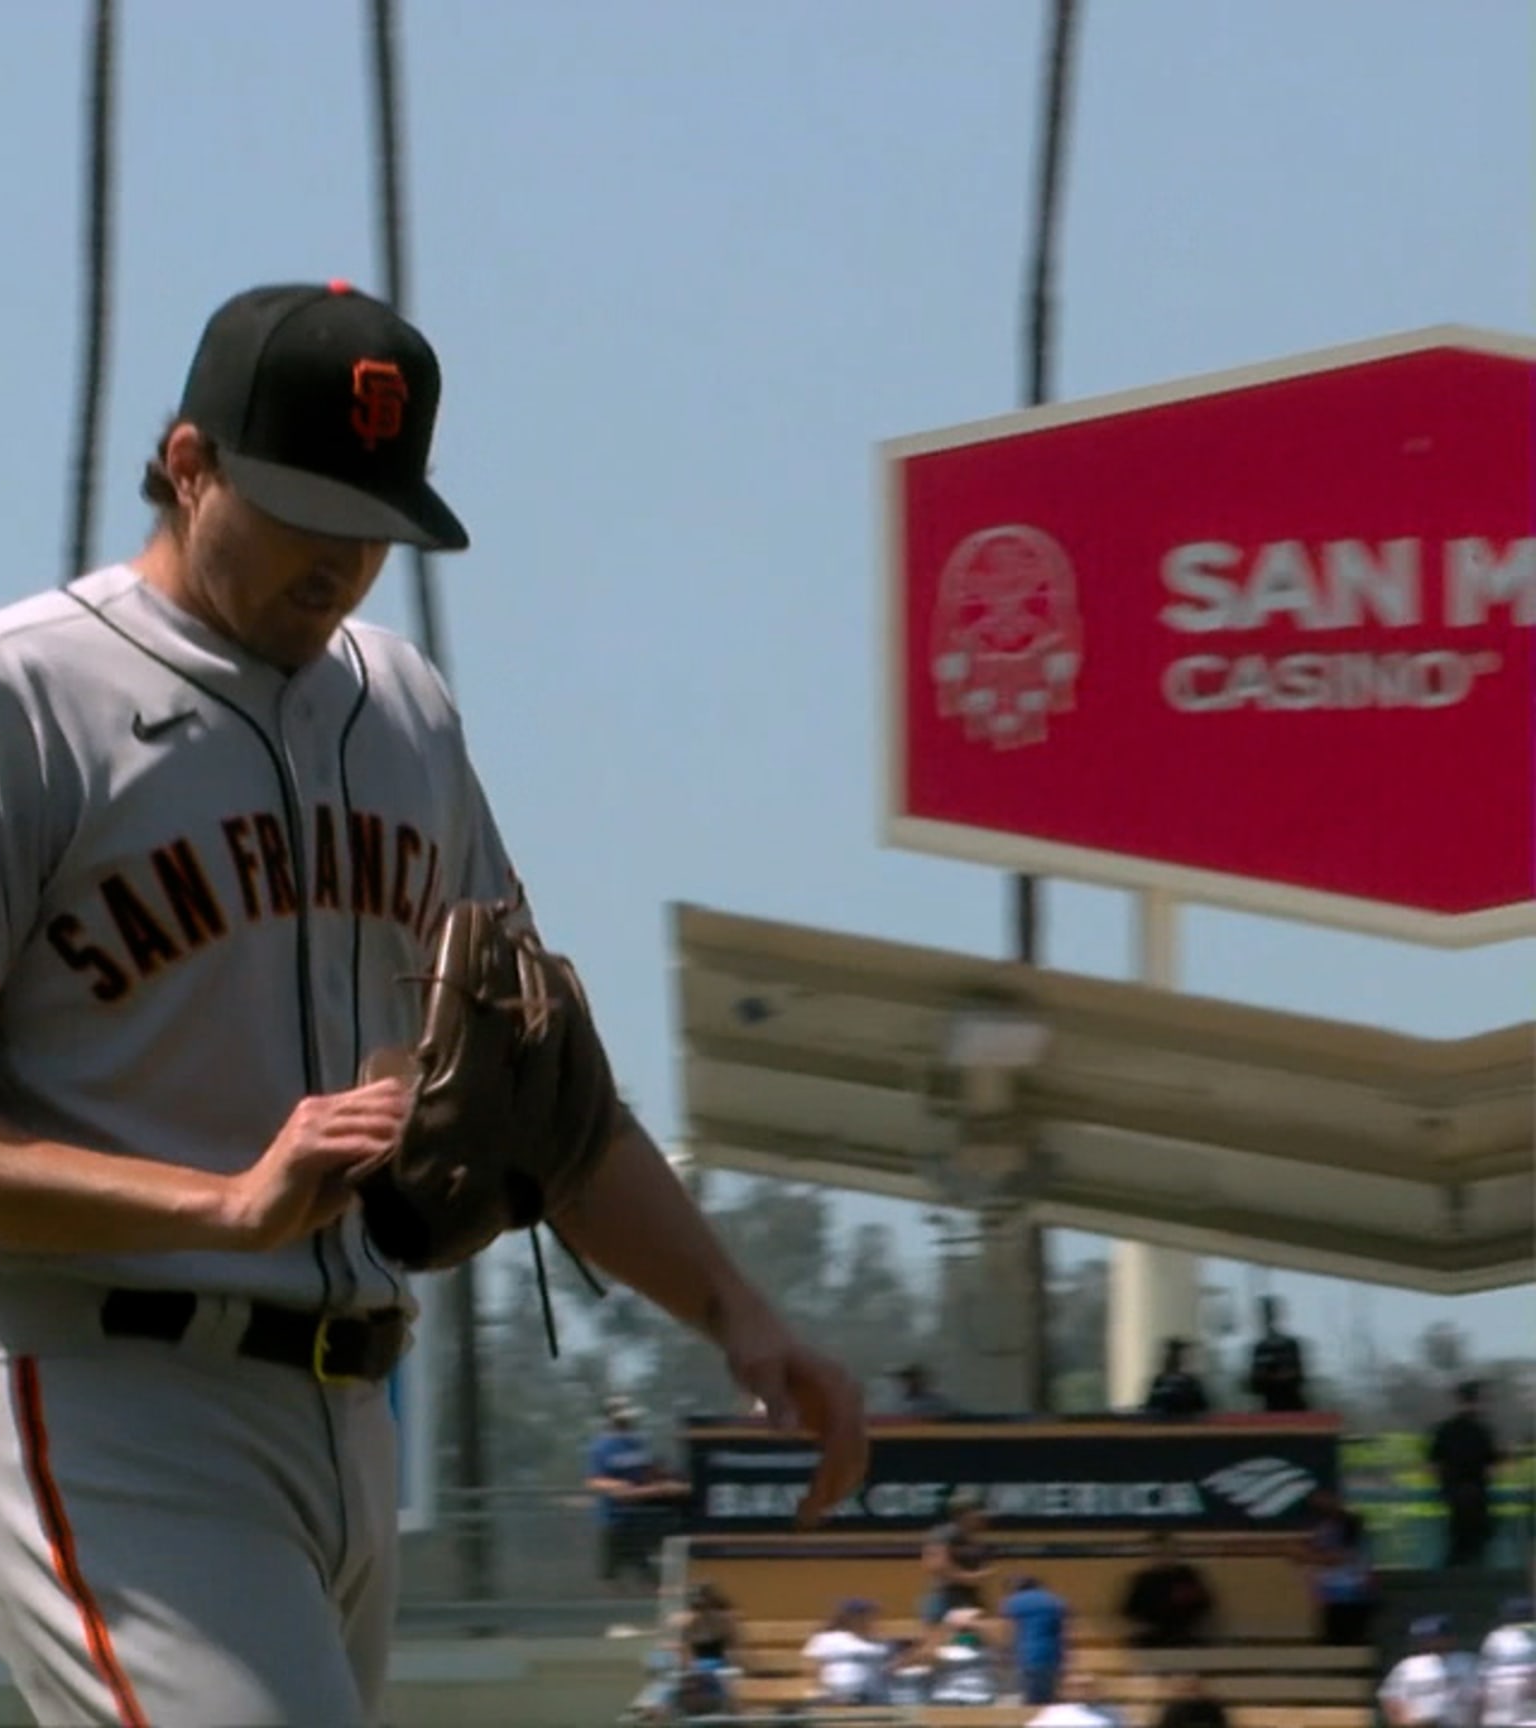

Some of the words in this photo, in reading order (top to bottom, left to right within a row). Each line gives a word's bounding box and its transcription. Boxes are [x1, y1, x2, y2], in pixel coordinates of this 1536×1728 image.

[351, 358, 409, 452] SF
[1158, 537, 1422, 633] SAN
[1162, 650, 1476, 712] CASINO
[44, 836, 232, 1006] SAN
[865, 1483, 950, 1517] OF
